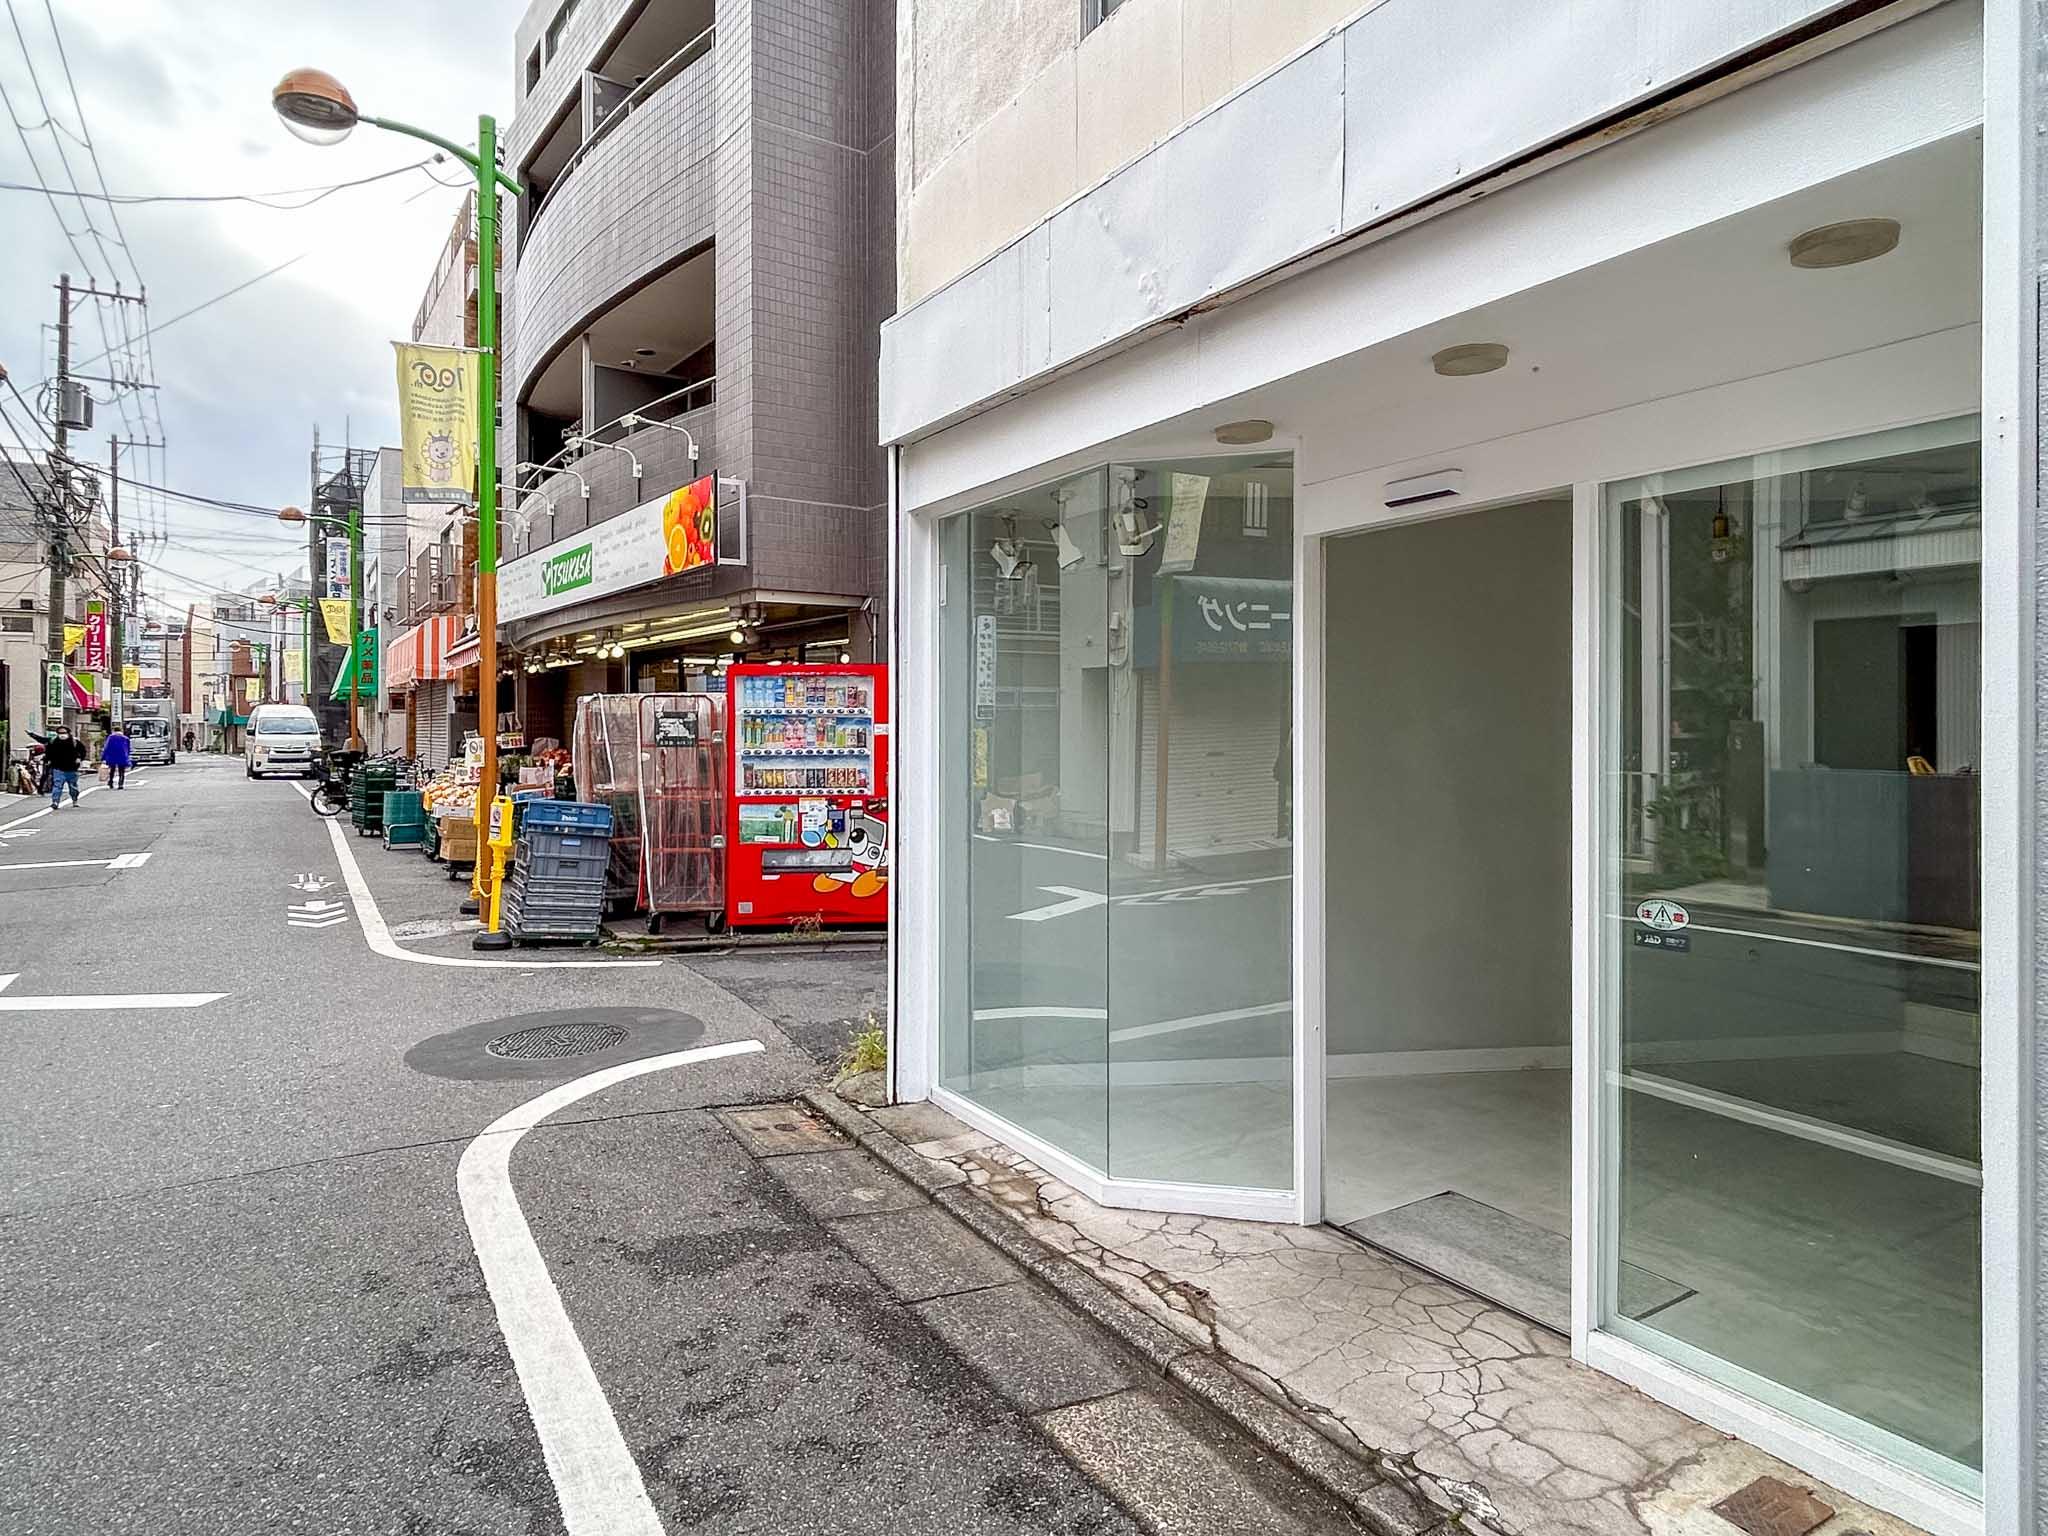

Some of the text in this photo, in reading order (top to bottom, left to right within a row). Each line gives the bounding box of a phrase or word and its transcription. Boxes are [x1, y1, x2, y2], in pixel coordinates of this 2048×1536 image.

[553, 550, 592, 588] TSUKASA
[88, 615, 104, 671] クリーニング
